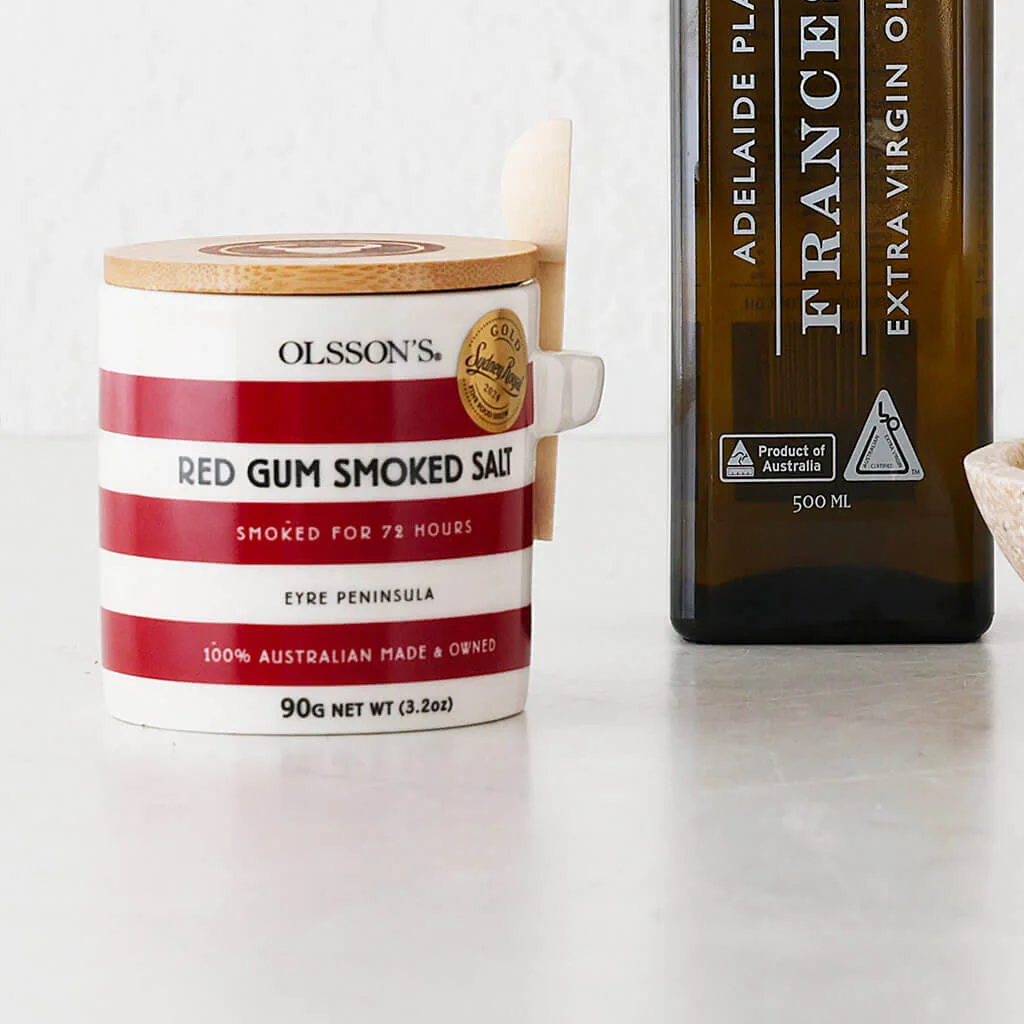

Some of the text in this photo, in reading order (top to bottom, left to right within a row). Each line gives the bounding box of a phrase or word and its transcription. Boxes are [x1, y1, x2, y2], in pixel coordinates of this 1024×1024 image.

[885, 64, 909, 198] VIRGIN
[732, 74, 756, 265] ADELAIDE
[886, 211, 910, 336] EXTRA
[490, 324, 521, 351] GOLD
[758, 444, 826, 457] Product of
[178, 447, 512, 488] RED GUM SMOKED SALT
[762, 459, 822, 472] Australia
[793, 495, 852, 513] 500 ML
[236, 520, 472, 541] SMOKED FOR 72 HOURS
[285, 586, 435, 605] EYRE PENINSULA
[203, 638, 497, 664] 100% AUSTRALIAN MADE & OWNED
[280, 696, 453, 718] 90G NET WT (3.2oz)
